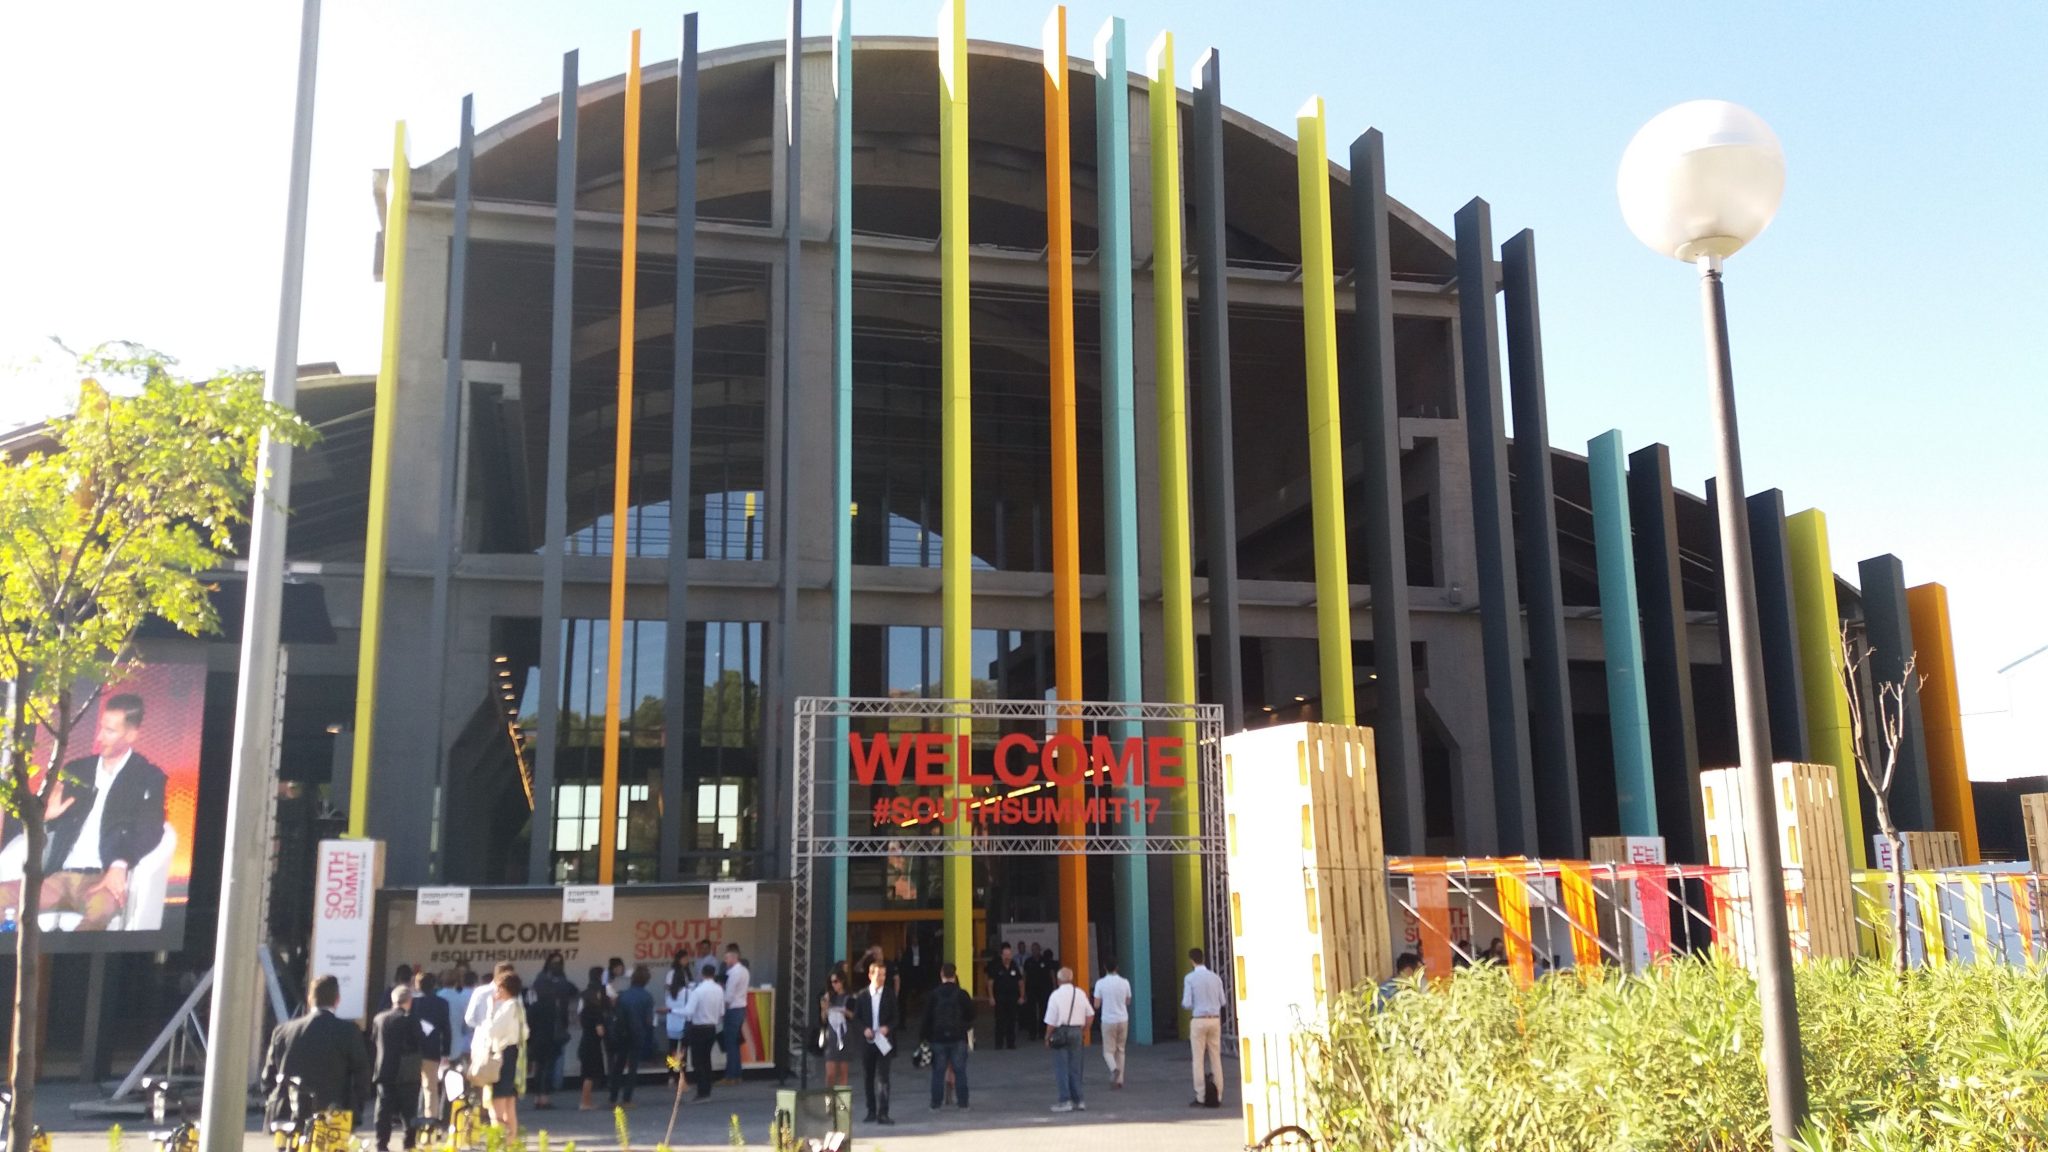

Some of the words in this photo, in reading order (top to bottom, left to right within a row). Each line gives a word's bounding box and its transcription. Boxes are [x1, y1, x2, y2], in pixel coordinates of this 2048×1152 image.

[848, 732, 1185, 787] WELCOME
[873, 797, 1161, 825] #SOUTHSUMMIT17
[325, 851, 345, 920] SOUTH
[342, 852, 360, 920] SUMMIT
[432, 922, 580, 945] WELCOME
[634, 919, 723, 941] SOUTH
